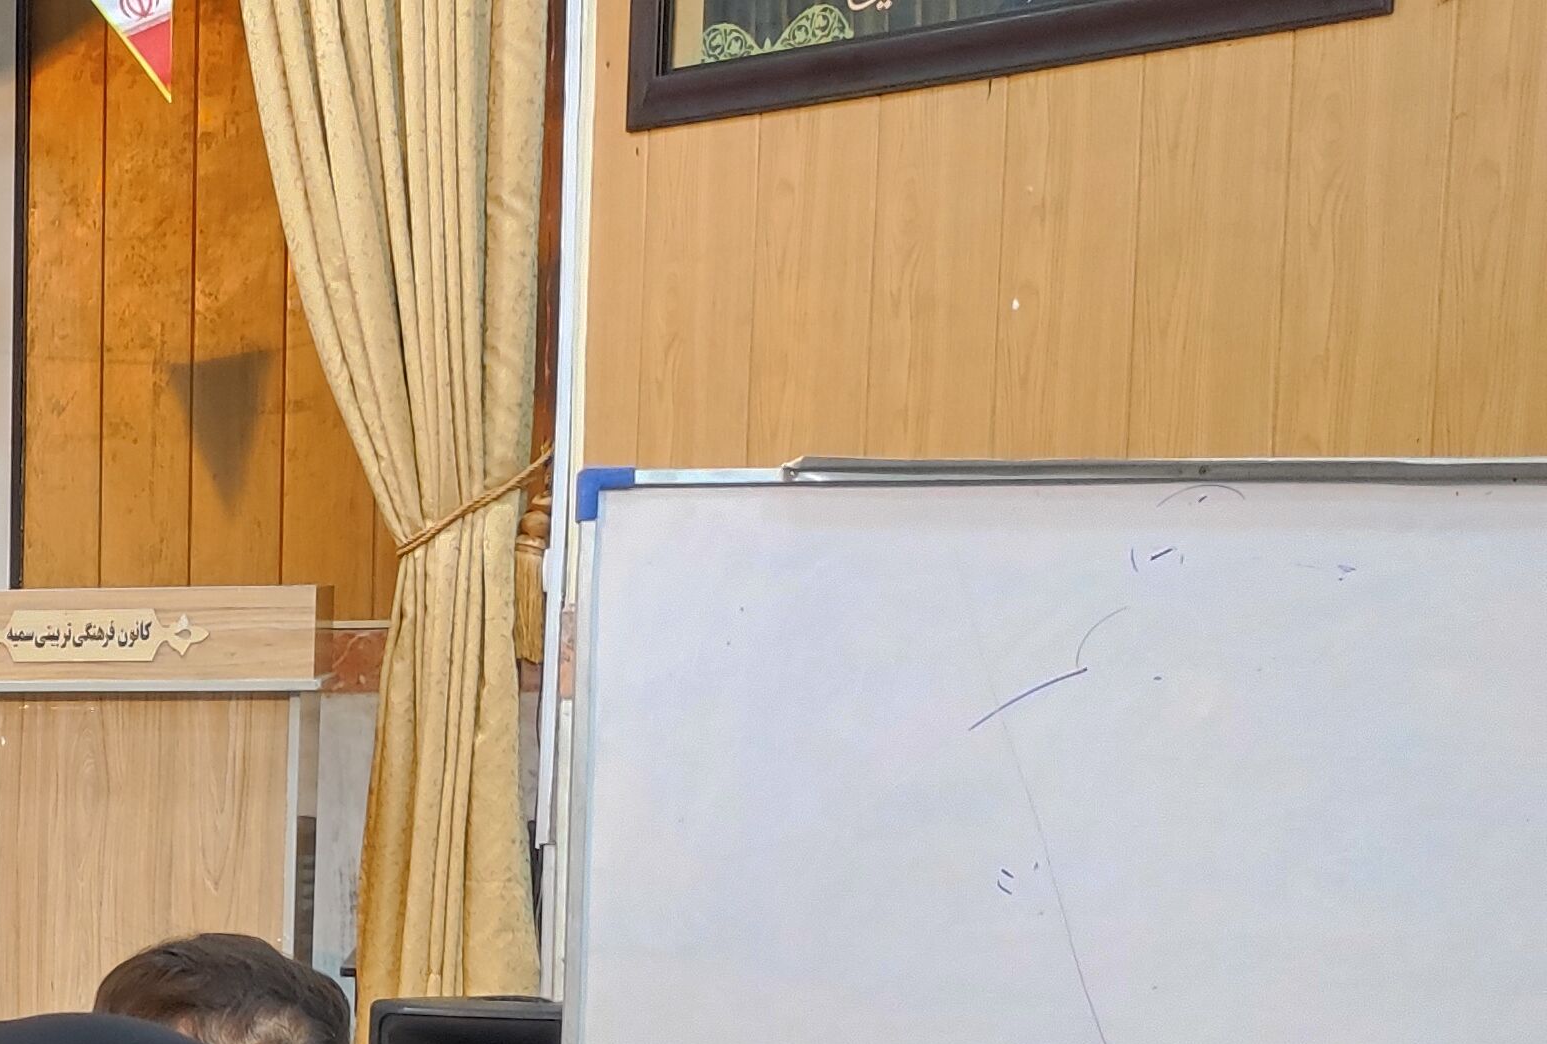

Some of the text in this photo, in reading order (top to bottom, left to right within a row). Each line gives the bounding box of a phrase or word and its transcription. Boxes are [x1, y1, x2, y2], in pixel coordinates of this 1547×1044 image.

[6, 620, 152, 649] کانون فرهنگی تربیتی سمیه
